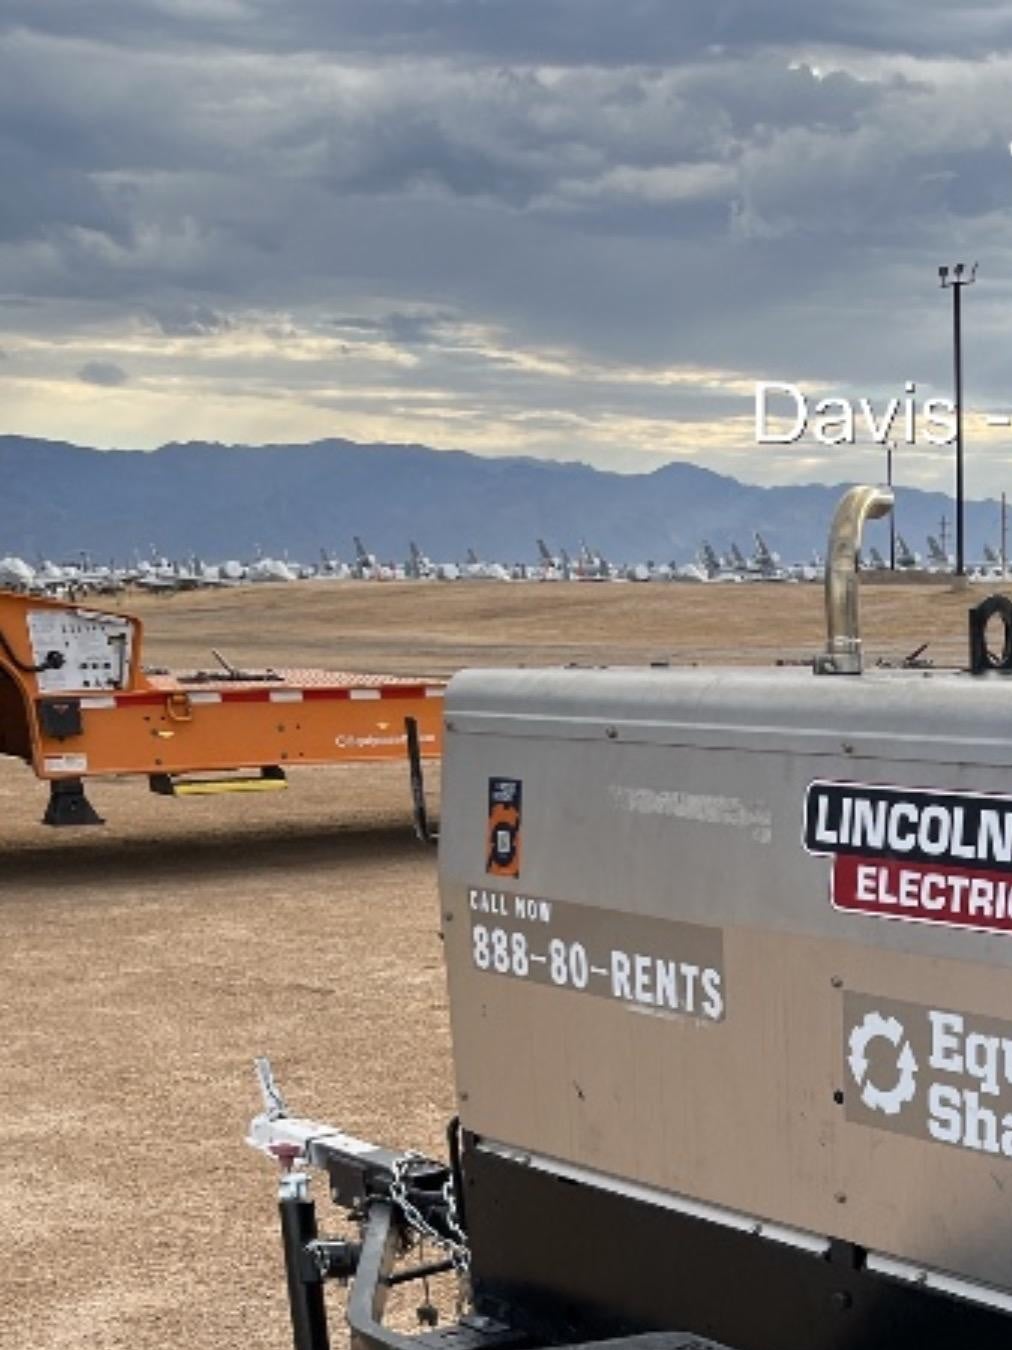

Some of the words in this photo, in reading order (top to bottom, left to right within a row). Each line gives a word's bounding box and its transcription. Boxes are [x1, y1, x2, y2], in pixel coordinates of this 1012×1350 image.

[469, 889, 508, 917] CALL
[514, 896, 553, 924] NOW
[472, 923, 725, 1022] 888-80-RENTS
